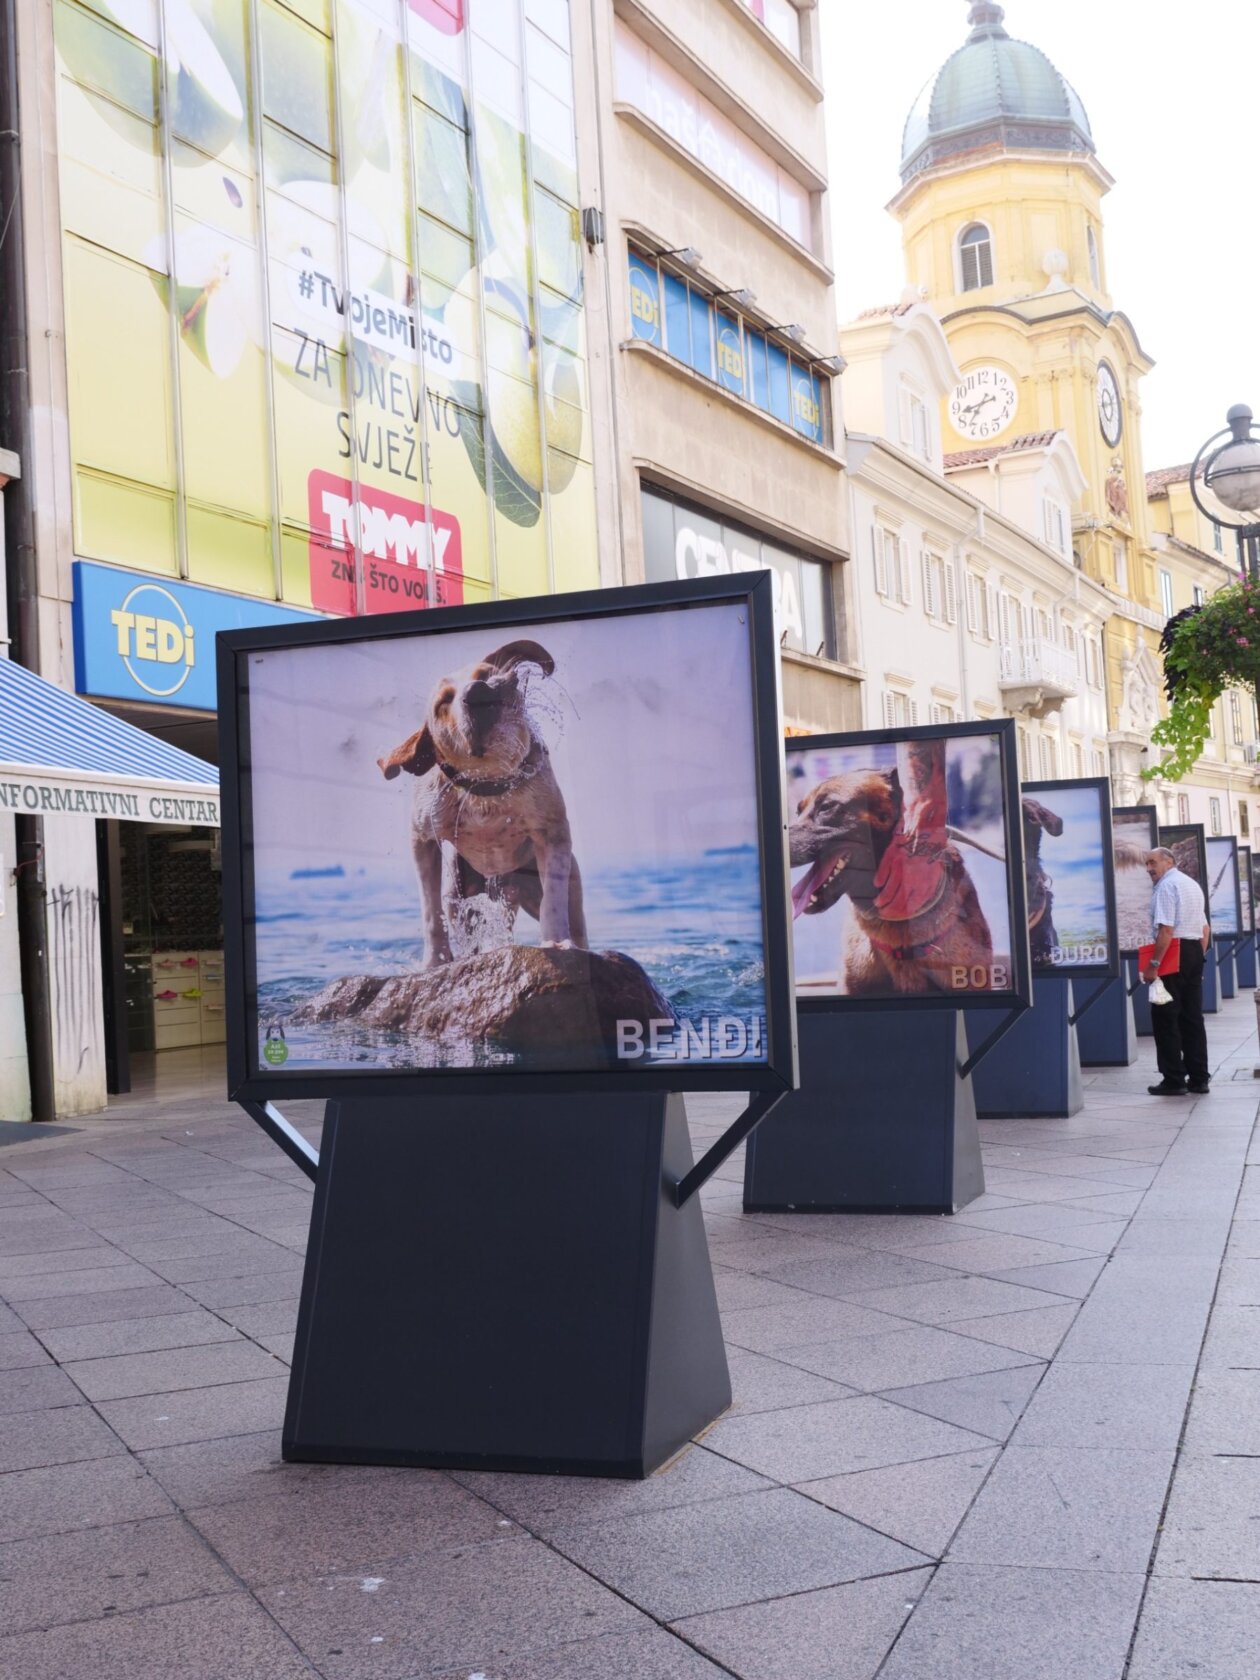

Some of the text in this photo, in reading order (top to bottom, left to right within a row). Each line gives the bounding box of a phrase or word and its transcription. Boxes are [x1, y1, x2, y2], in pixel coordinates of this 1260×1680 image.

[294, 327, 332, 388] ZA
[967, 375, 975, 390] 11
[978, 370, 988, 385] 12
[994, 372, 997, 386] 1
[1000, 377, 1007, 391] 2
[956, 385, 967, 399] 10
[1006, 390, 1014, 405] 3
[793, 389, 820, 428] TEDi
[952, 401, 960, 415] 9
[1001, 405, 1009, 419] 4
[958, 414, 967, 428] 8
[969, 422, 977, 435] 7
[992, 417, 1000, 432] 5
[980, 422, 989, 437] 6
[322, 490, 452, 575] TOMMY
[370, 563, 399, 593] ŠTO
[111, 609, 195, 667] TEDi
[150, 797, 219, 823] CENTAR
[951, 964, 1008, 989] BOB
[616, 1016, 762, 1059] BENĐI
